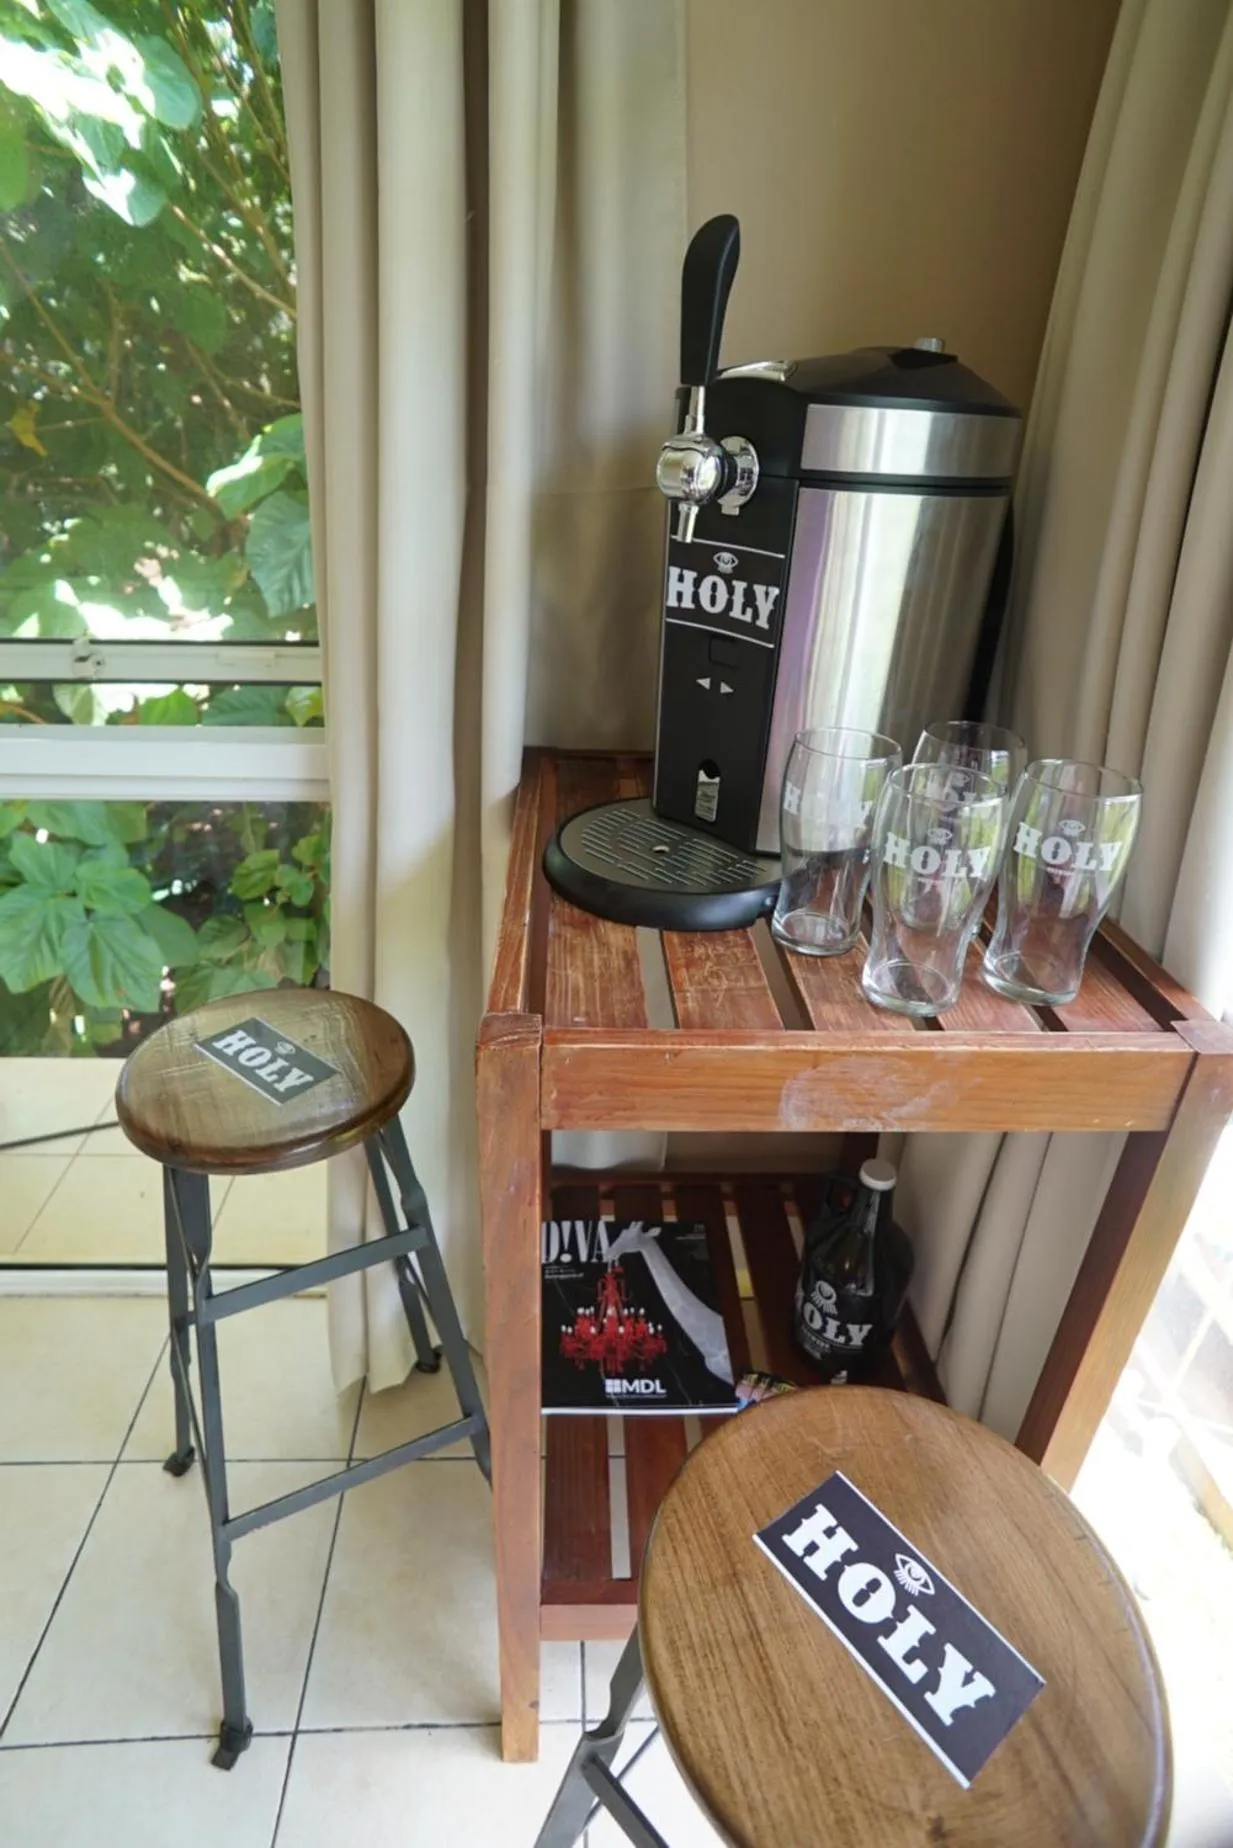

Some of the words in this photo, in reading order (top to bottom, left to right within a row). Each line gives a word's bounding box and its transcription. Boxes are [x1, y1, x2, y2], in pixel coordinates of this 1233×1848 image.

[666, 565, 780, 629] HOLY
[883, 831, 992, 882] HOLY
[1013, 821, 1123, 872] HOLY
[211, 1029, 315, 1093] HOLY
[803, 1301, 873, 1346] OLY
[622, 1379, 669, 1394] MDL
[781, 1503, 996, 1727] HOLY
